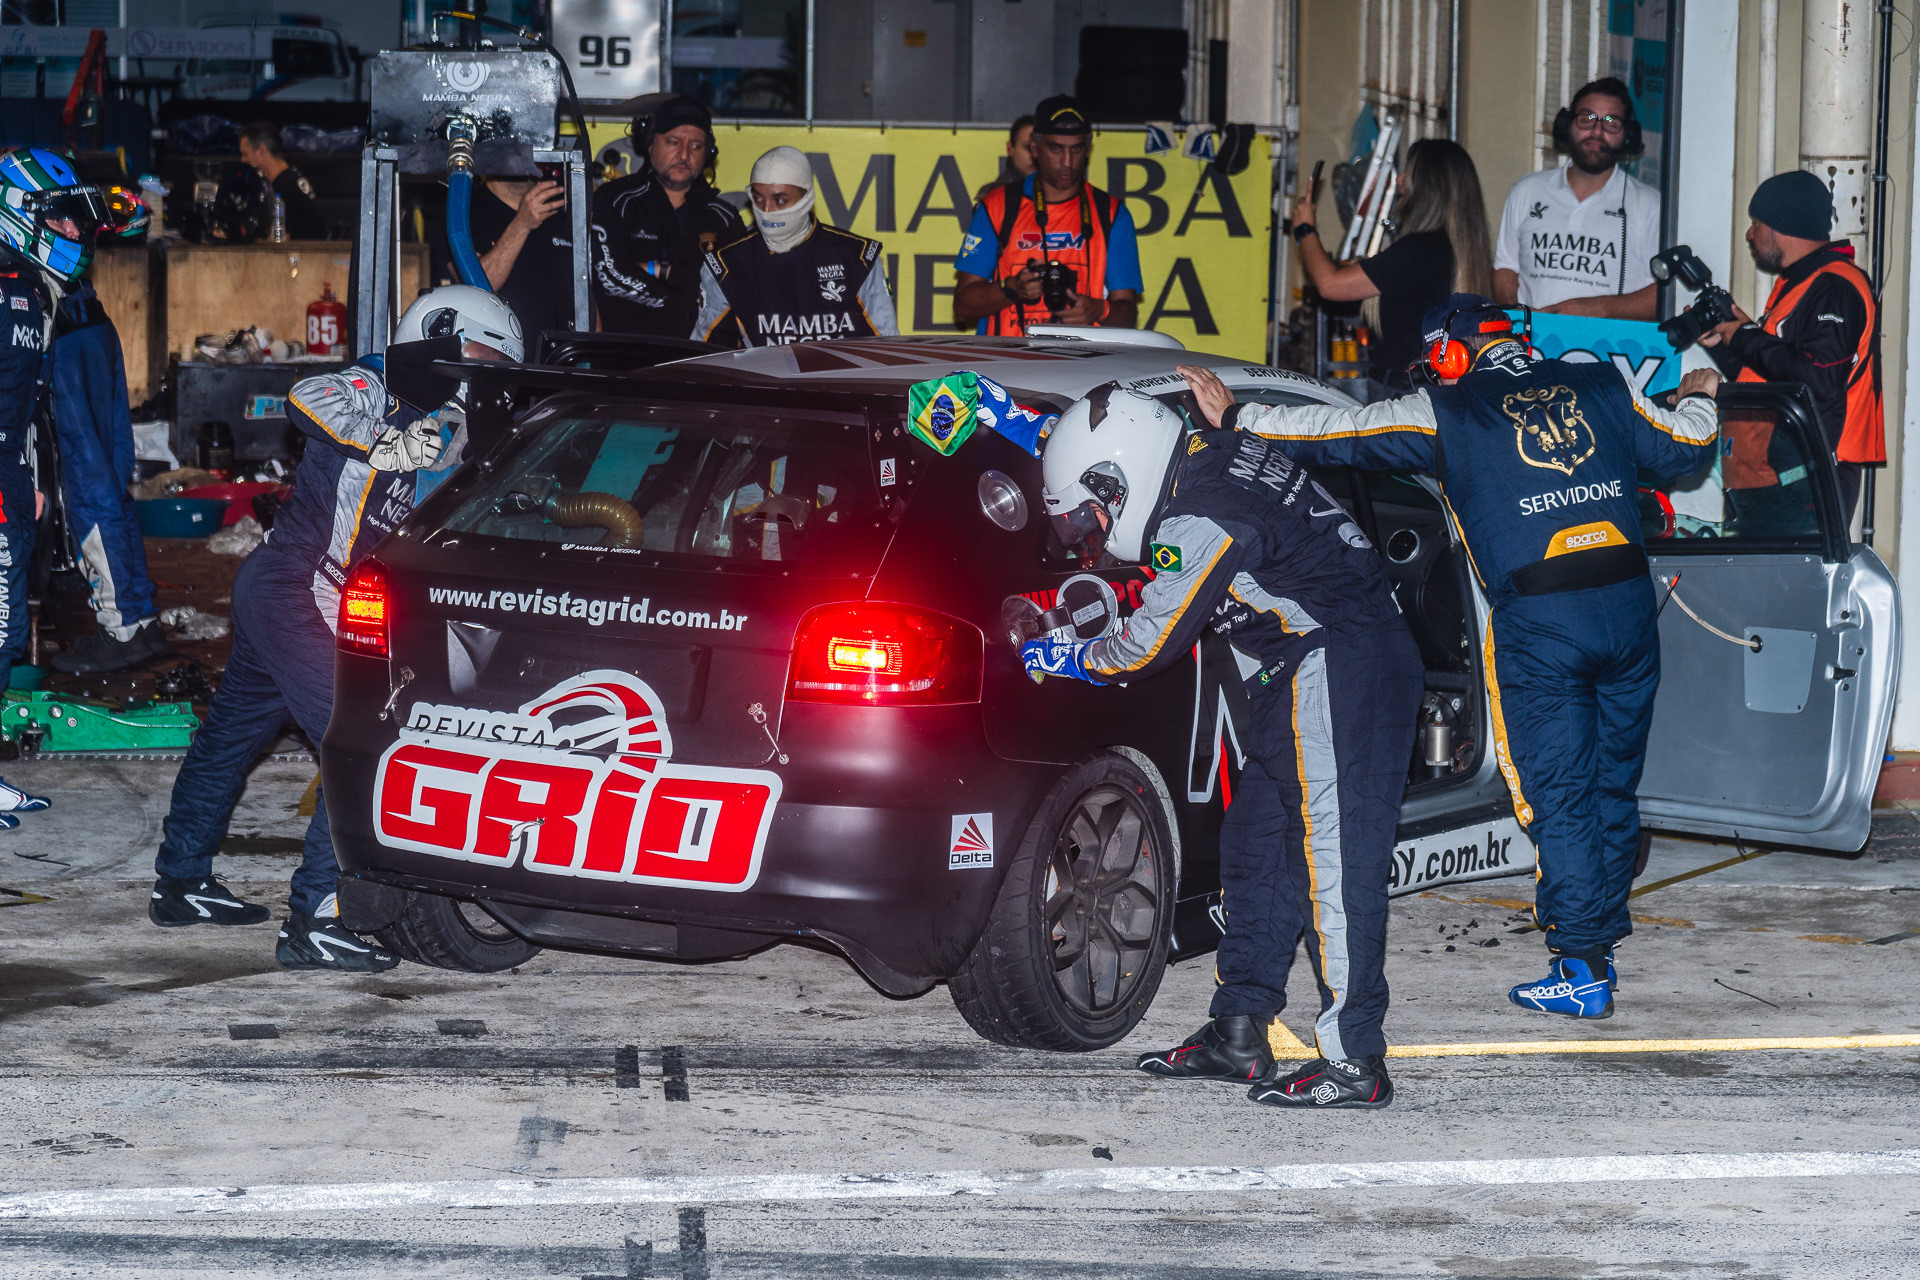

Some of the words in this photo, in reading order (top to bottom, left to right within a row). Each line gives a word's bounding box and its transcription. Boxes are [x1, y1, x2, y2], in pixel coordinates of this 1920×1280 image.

[579, 36, 631, 67] 96
[422, 94, 467, 102] MAMBA
[470, 94, 511, 102] NEGRA
[806, 153, 1252, 238] MABA
[1530, 233, 1617, 260] MAMBA
[817, 264, 845, 274] MAMBA
[1534, 252, 1607, 277] NEGRA
[307, 315, 338, 346] 85
[758, 312, 855, 334] MAMBA
[1131, 375, 1171, 391] ANDREW
[1519, 480, 1623, 516] SERVIDONE
[367, 514, 381, 527] High
[1566, 530, 1608, 548] sparco
[429, 587, 748, 632] www.revistagrid.com.br
[1496, 740, 1525, 804] NEGRA
[951, 852, 992, 865] Delta
[1530, 981, 1573, 1000] sparco
